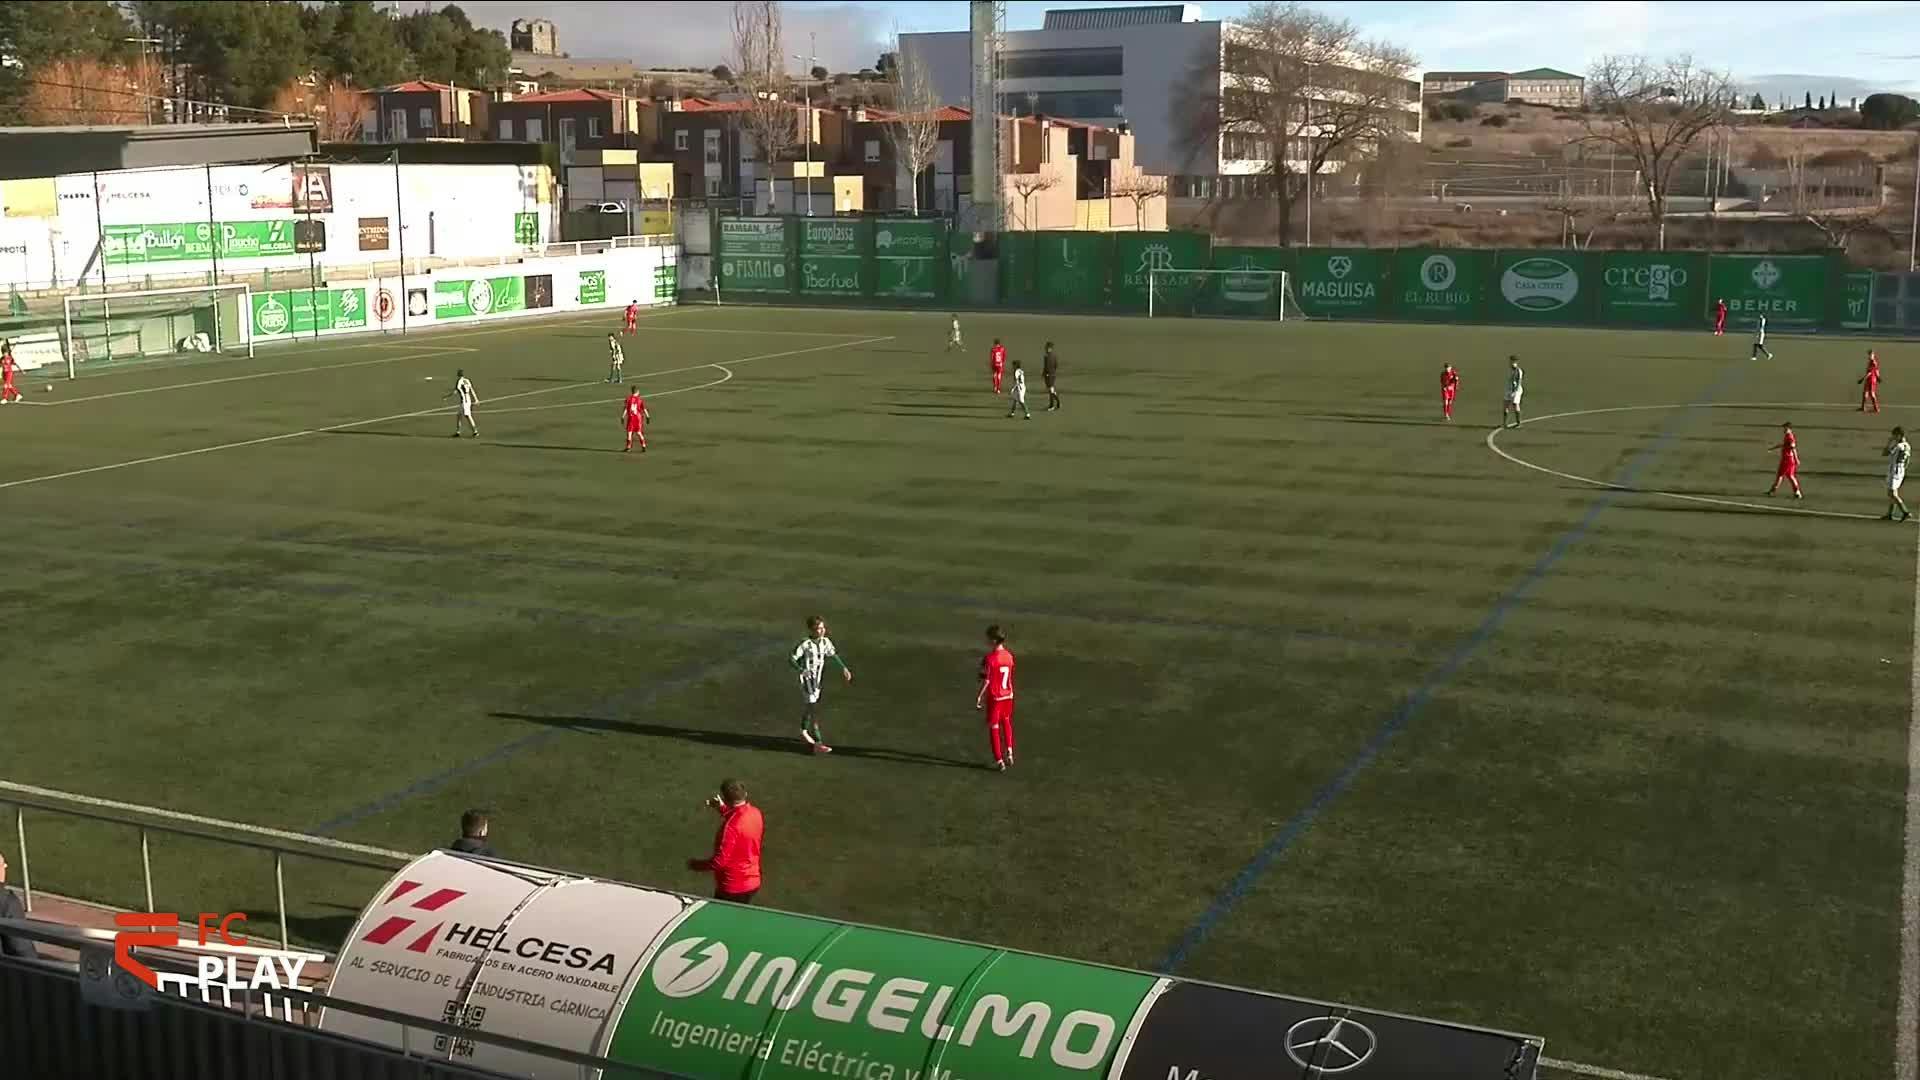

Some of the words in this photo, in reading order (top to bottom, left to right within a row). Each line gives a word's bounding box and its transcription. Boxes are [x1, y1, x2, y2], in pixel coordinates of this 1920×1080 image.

[1302, 280, 1375, 298] MAGUISA
[1730, 299, 1797, 311] BEHER
[999, 665, 1010, 690] 7
[444, 922, 616, 975] HELCESA
[349, 955, 365, 969] AL
[370, 960, 431, 983] SERVICIO
[433, 973, 452, 987] DE
[473, 981, 546, 1008] INDUSTRIA
[501, 961, 517, 972] EN
[517, 965, 554, 980] ACERO
[555, 973, 619, 993] INOXIDABLE
[723, 951, 1117, 1071] INGELMO
[650, 1010, 776, 1060] Ingeniería
